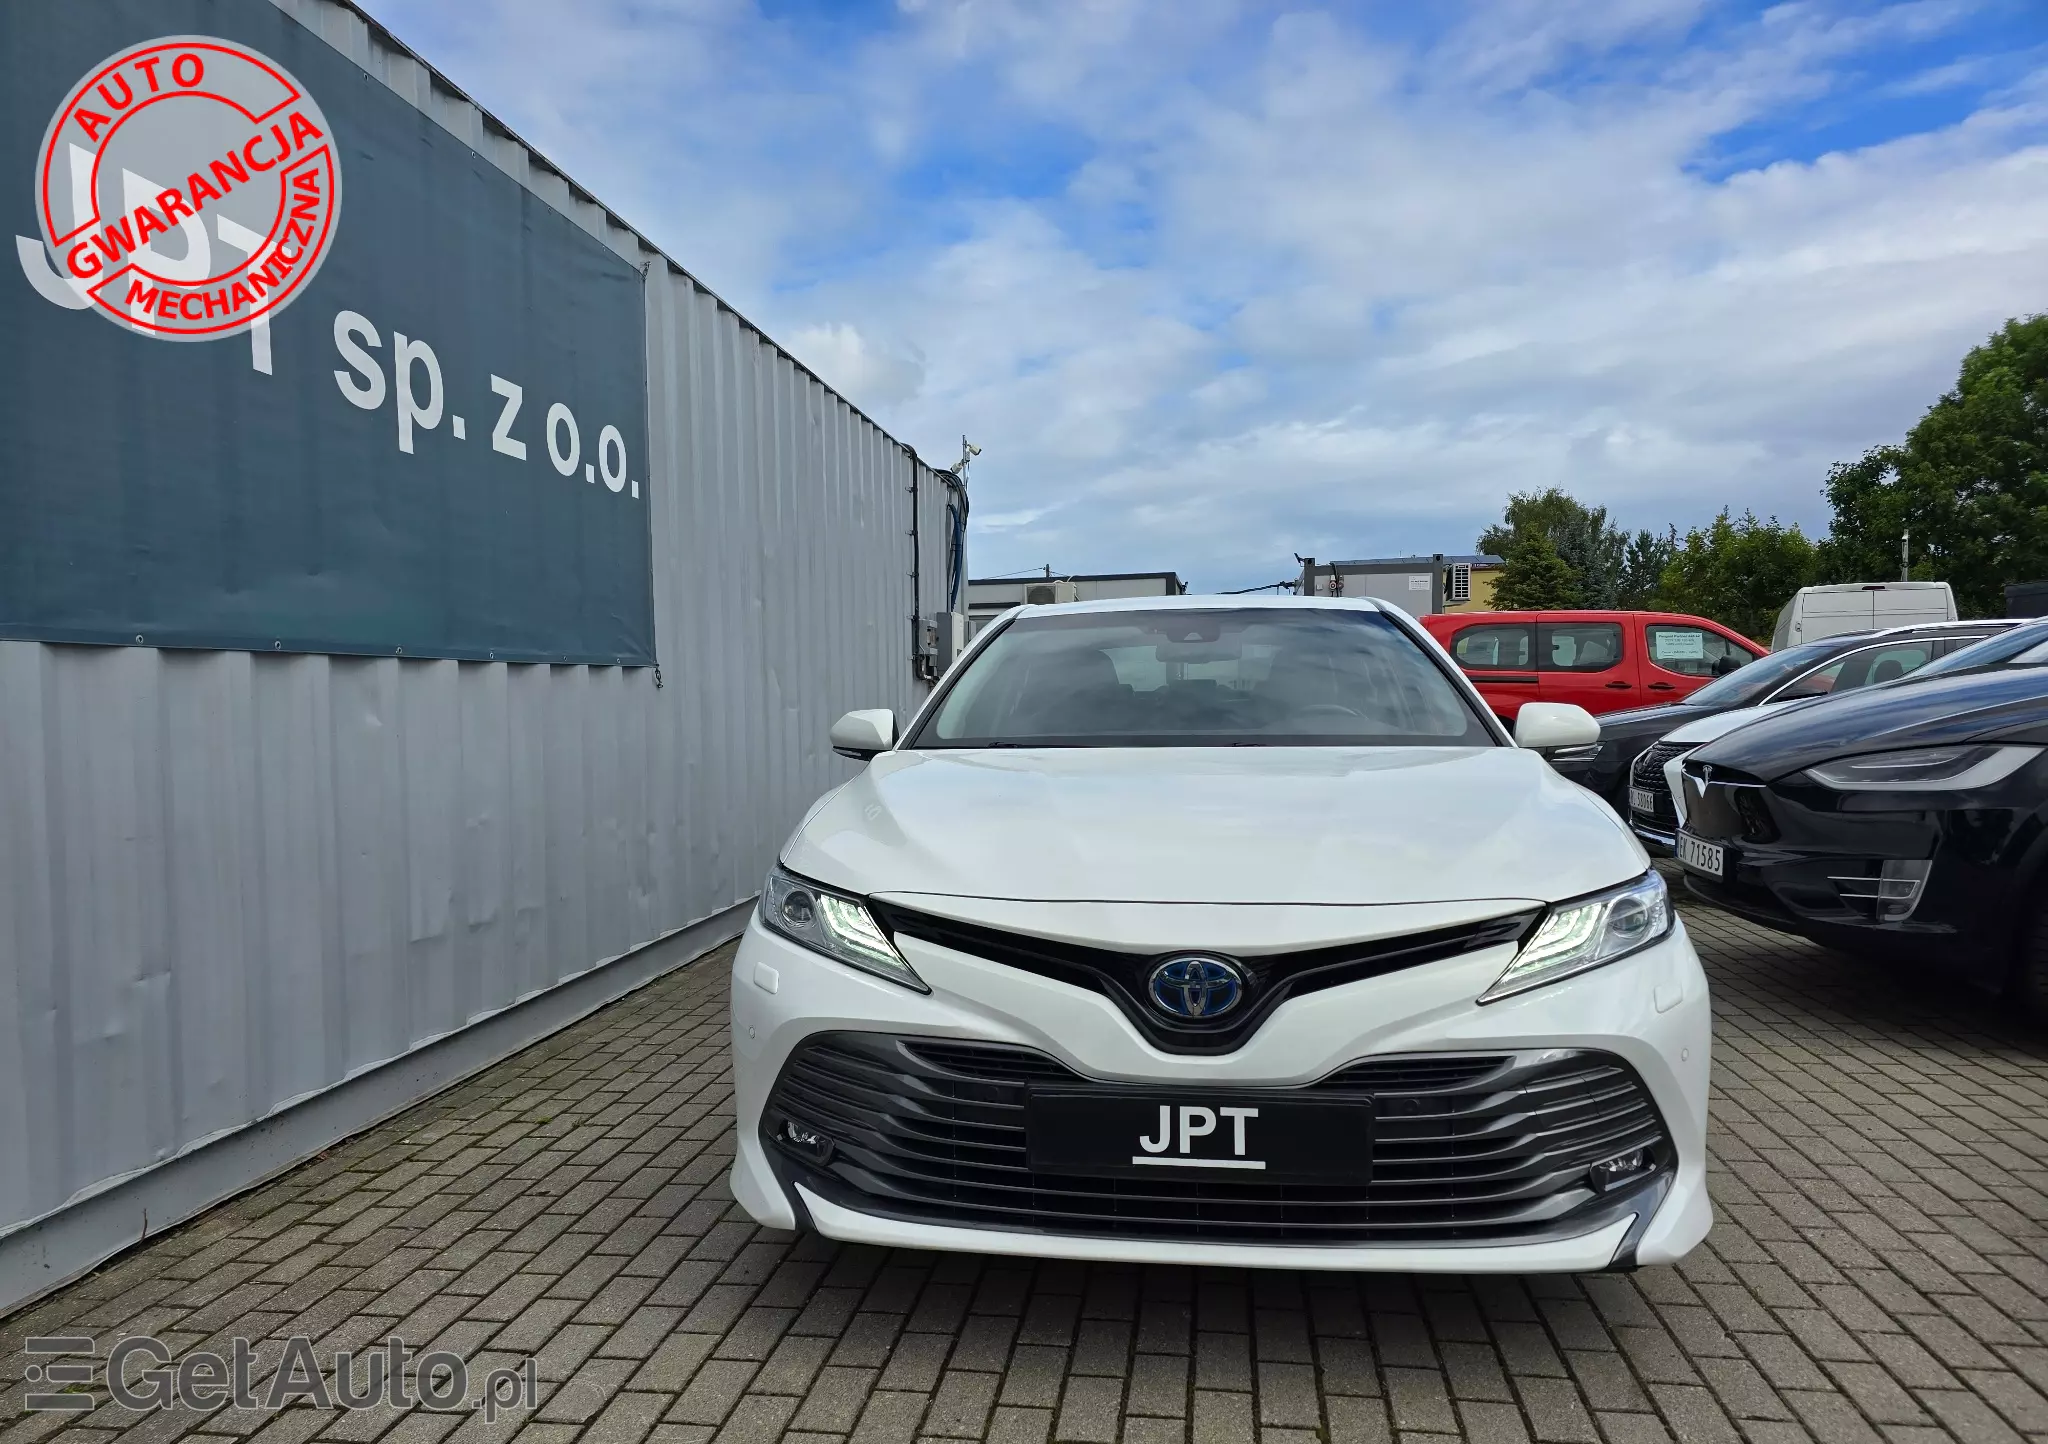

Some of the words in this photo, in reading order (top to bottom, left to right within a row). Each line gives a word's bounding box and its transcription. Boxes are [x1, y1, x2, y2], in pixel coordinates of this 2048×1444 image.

[15, 142, 293, 376] JPT
[333, 310, 466, 455] sp.
[490, 373, 527, 461] z
[546, 402, 640, 500] o.o.
[1690, 840, 1721, 872] 71585
[1139, 1105, 1259, 1156] JPT
